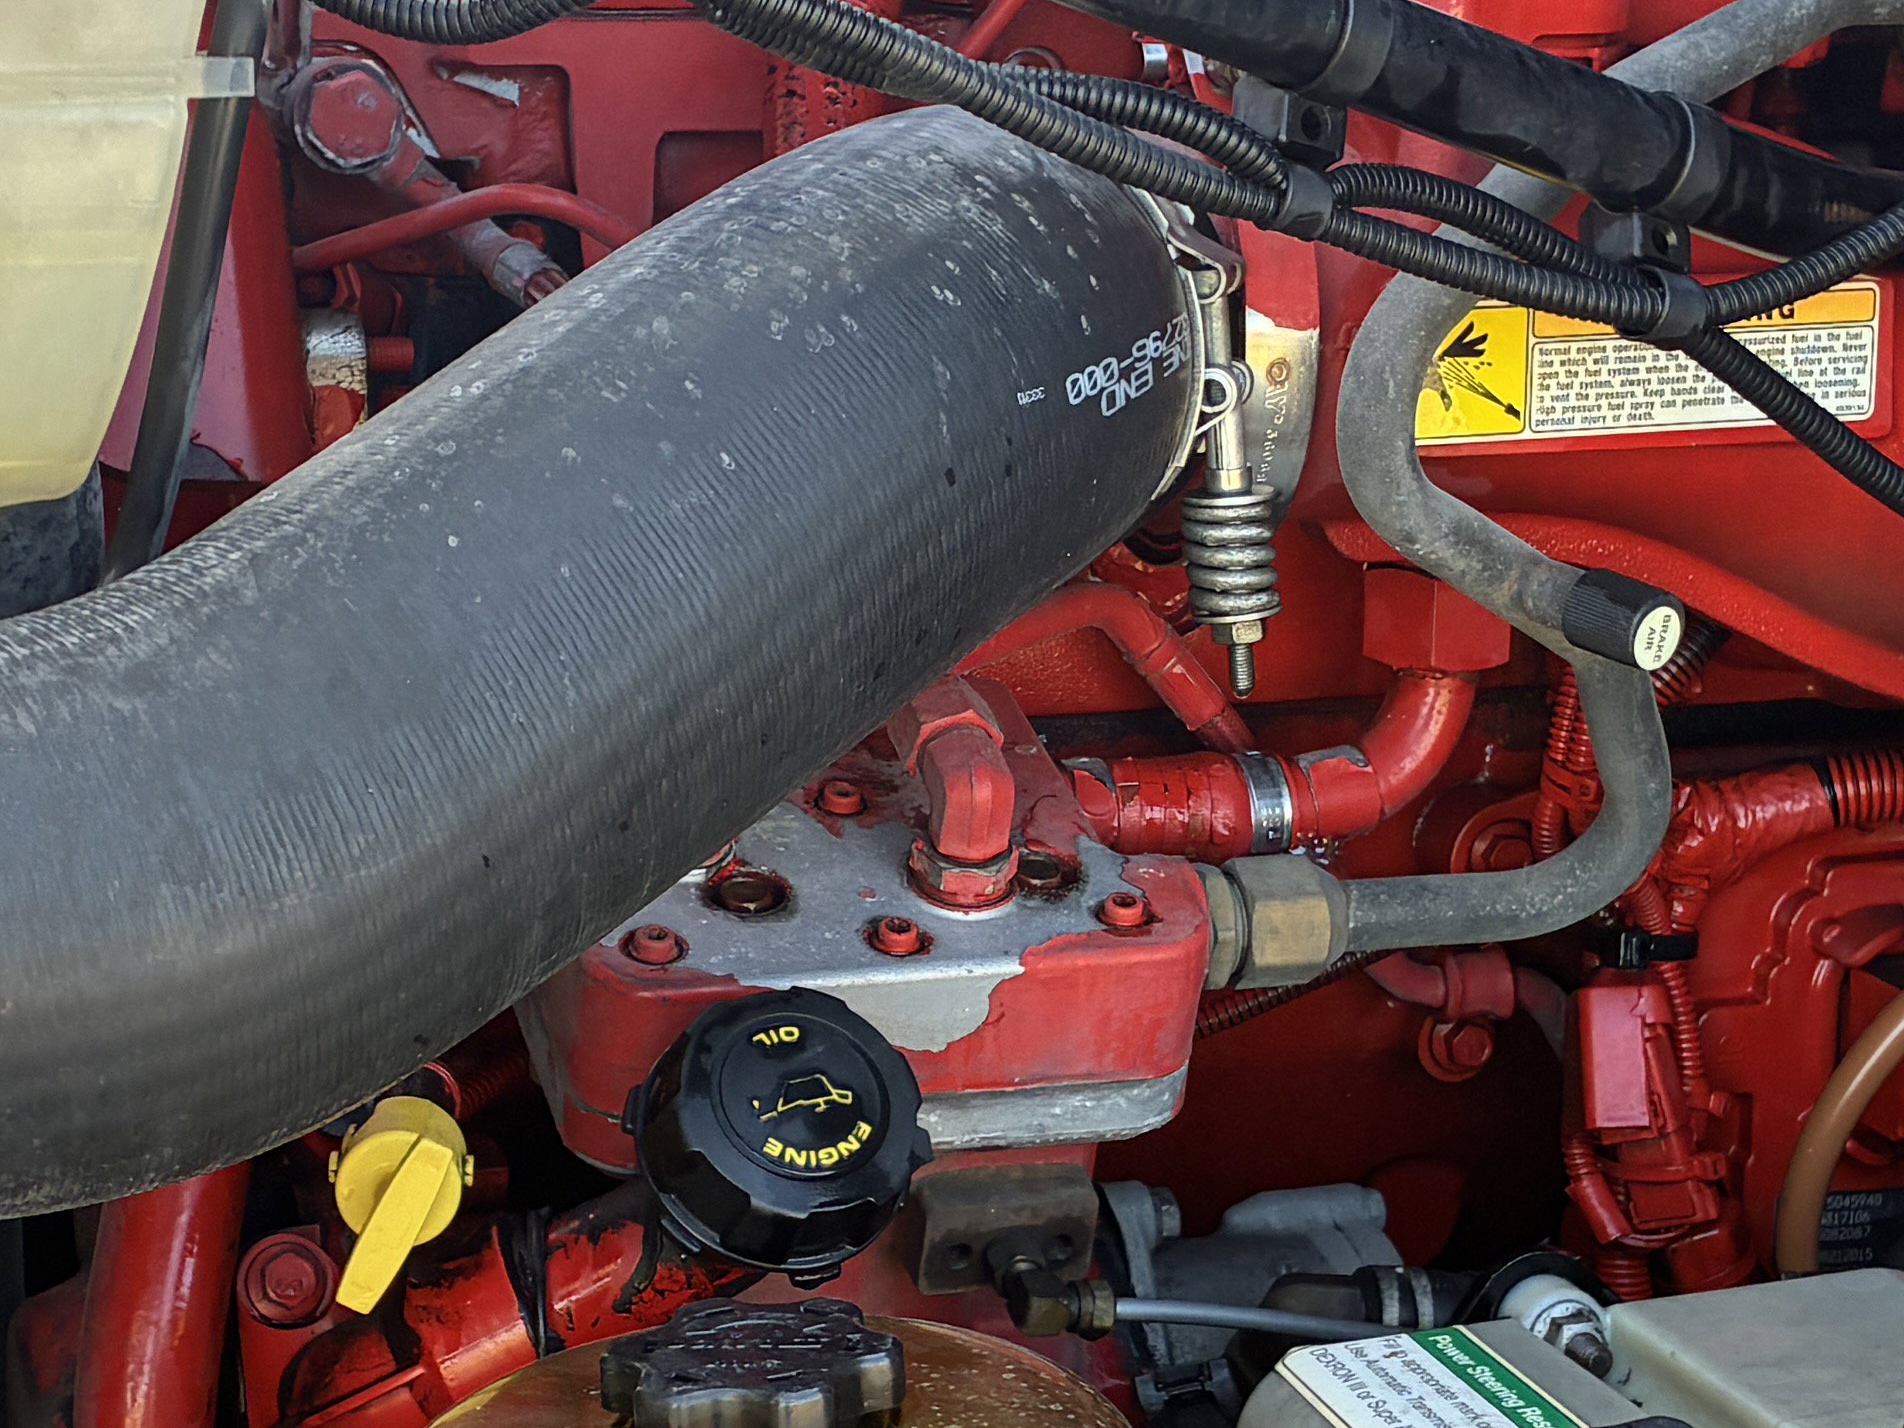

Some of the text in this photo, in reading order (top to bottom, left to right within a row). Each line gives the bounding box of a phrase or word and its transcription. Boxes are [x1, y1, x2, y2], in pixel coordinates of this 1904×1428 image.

[1594, 356, 1609, 366] will
[1607, 366, 1640, 378] system
[1793, 357, 1822, 366] Before
[1100, 361, 1154, 418] END
[1643, 388, 1665, 399] Keep
[1562, 403, 1602, 415] pressure
[1653, 614, 1672, 663] BRAKE
[753, 1026, 800, 1048] OIL
[763, 1120, 872, 1167] ENGINE
[1310, 1348, 1354, 1385] DEXRON
[1368, 1398, 1399, 1428] Super
[1366, 1357, 1412, 1397] Automatic
[1428, 1334, 1474, 1372] Power
[1467, 1365, 1522, 1409] Steering
[1453, 1398, 1486, 1424] mark
